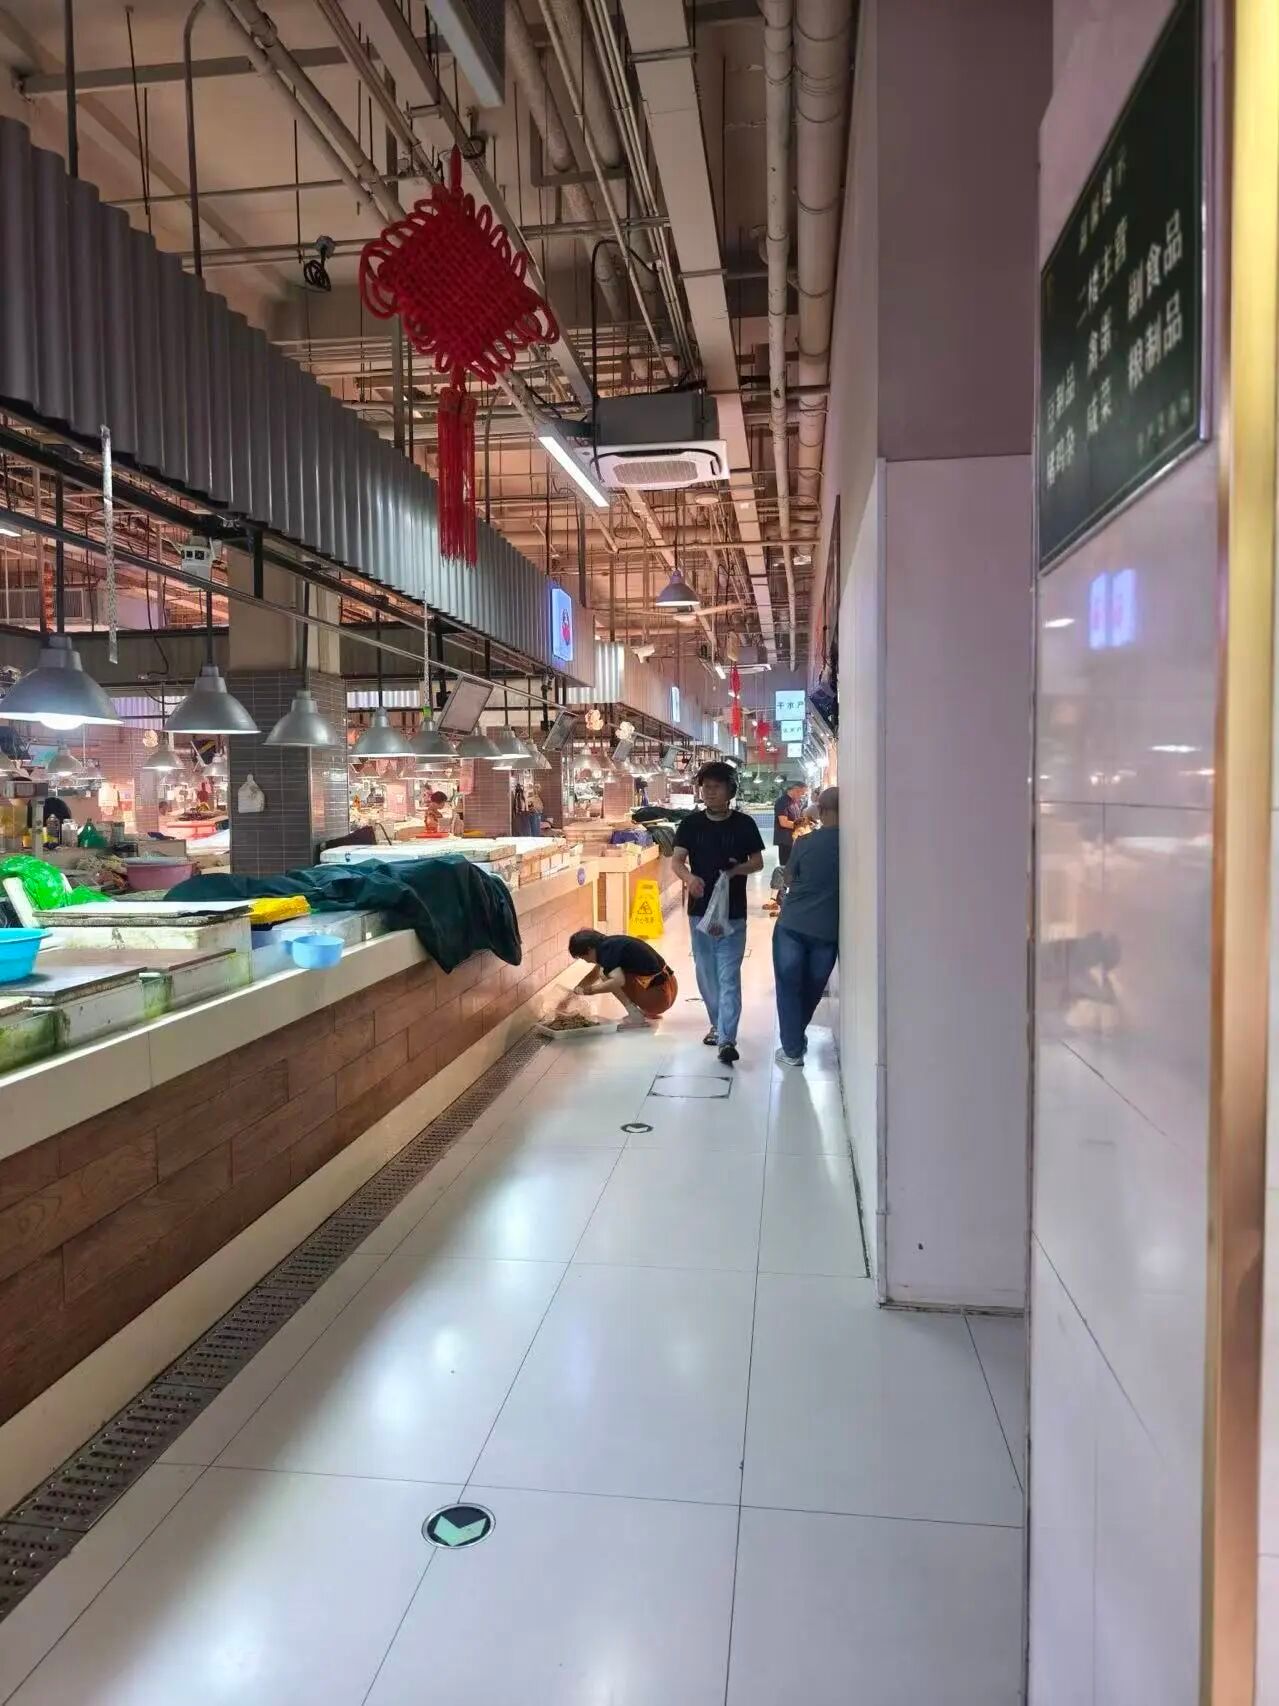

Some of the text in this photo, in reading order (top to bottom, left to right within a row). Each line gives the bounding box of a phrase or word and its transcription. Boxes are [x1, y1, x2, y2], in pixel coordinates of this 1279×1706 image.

[1077, 215, 1128, 327] 二楼主营
[1128, 209, 1183, 322] 副食品
